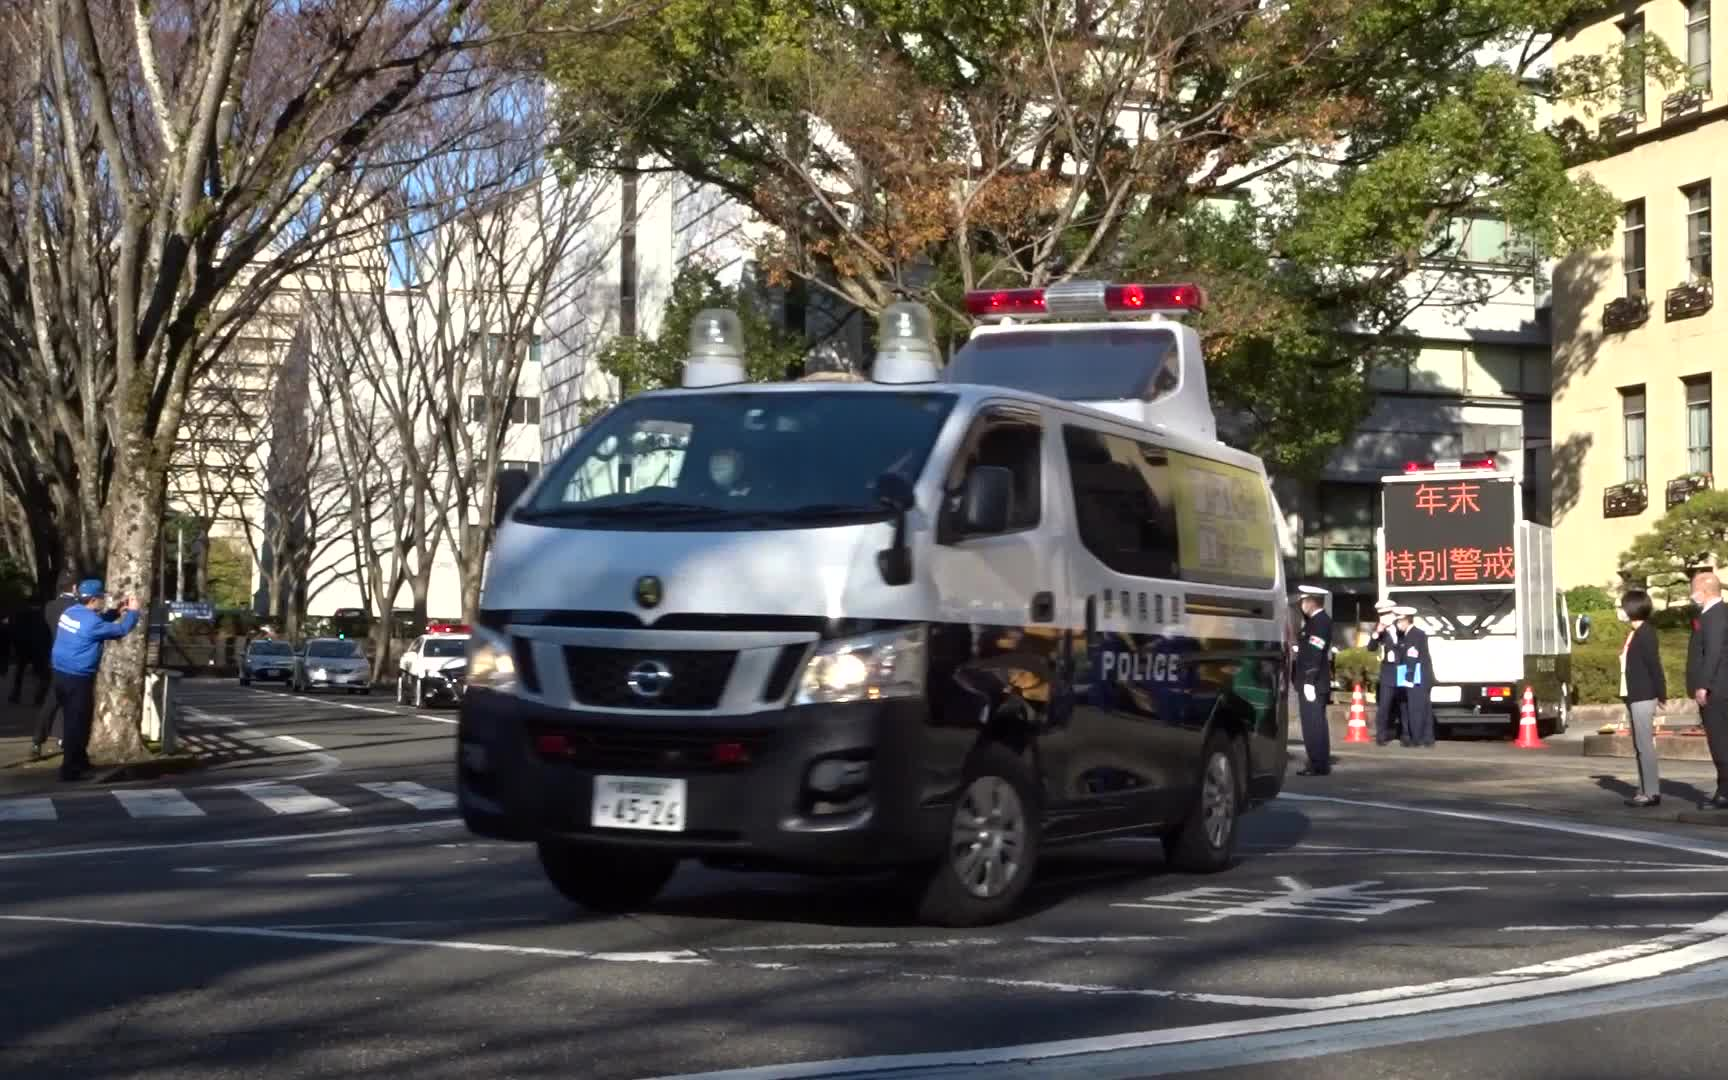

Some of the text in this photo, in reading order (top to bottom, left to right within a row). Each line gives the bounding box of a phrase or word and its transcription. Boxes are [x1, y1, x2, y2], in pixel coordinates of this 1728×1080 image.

[1415, 482, 1481, 515] 年末
[1385, 546, 1515, 582] 特別警戒
[1101, 650, 1180, 682] POLICE
